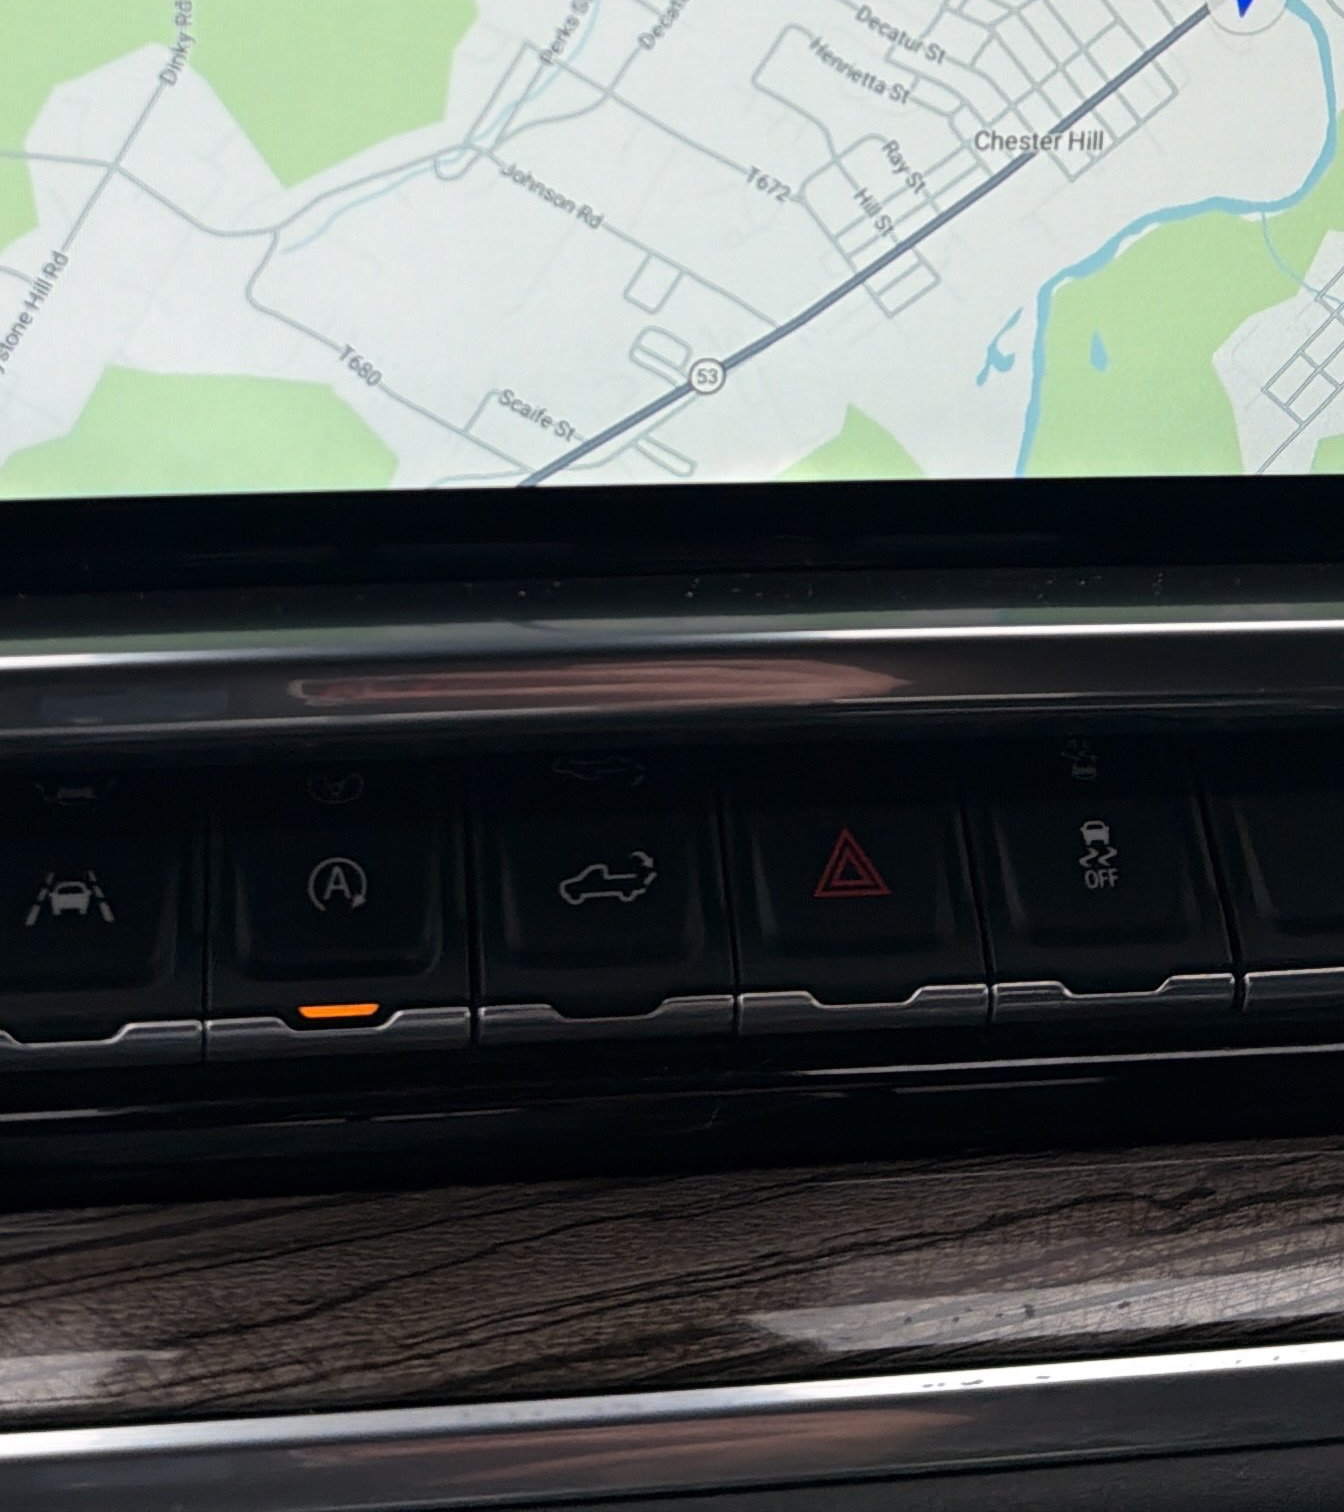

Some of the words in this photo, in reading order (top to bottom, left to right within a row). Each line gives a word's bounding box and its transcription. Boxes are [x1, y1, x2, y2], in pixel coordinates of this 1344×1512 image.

[175, 0, 193, 29] Rd
[856, 5, 921, 53] Decatur
[925, 43, 946, 64] St
[159, 32, 196, 87] Dinky
[809, 36, 885, 94] Henrietta
[888, 83, 911, 105] St
[975, 130, 1062, 152] Chester
[1069, 130, 1104, 151] Hill
[746, 167, 791, 202] T672
[882, 139, 911, 175] Ray
[906, 172, 926, 194] St
[499, 163, 576, 215] Johnson
[576, 204, 604, 229] Rd
[853, 187, 882, 220] Hill
[875, 215, 894, 237] St
[39, 249, 70, 281] Rd
[25, 277, 54, 312] Hill
[338, 345, 382, 386] T680
[698, 369, 719, 384] 53
[498, 390, 555, 431] Scaife
[554, 420, 575, 442] St
[1084, 868, 1119, 889] OFF
